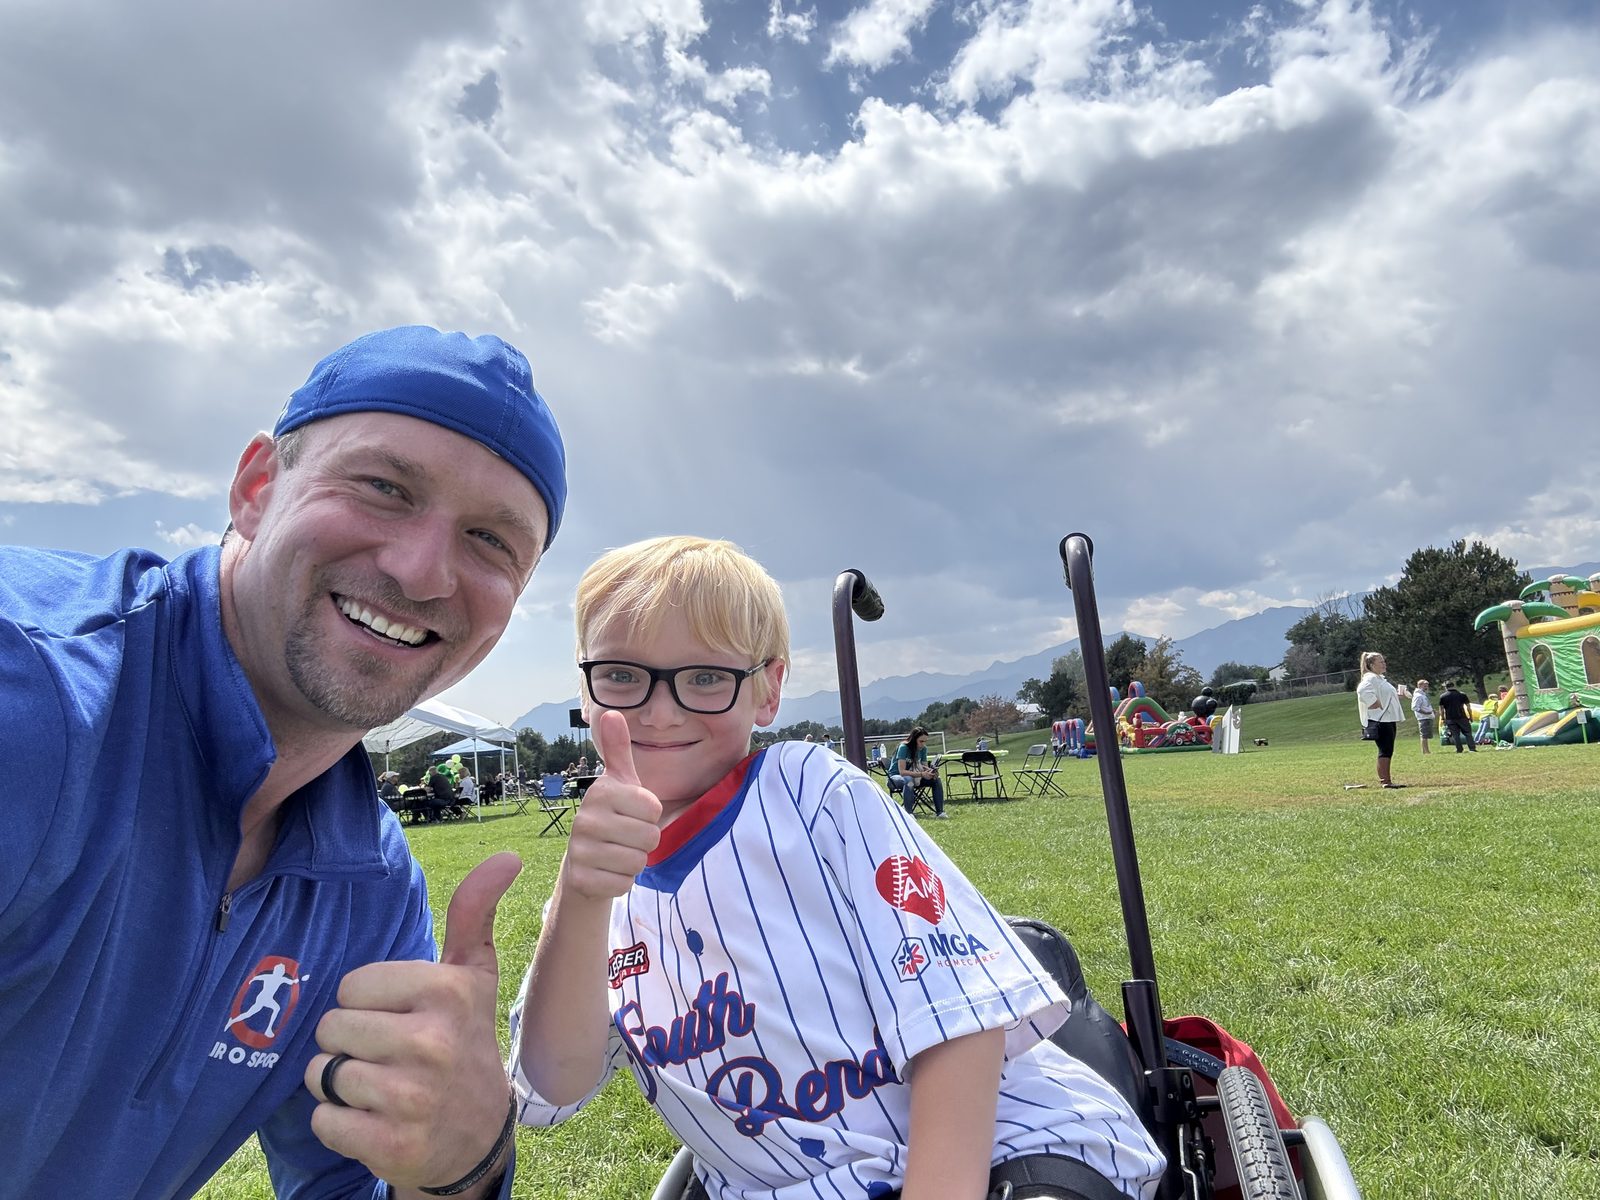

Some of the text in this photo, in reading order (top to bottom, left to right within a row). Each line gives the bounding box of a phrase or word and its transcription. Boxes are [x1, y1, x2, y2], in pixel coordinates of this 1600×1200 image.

[928, 934, 989, 956] MGA
[614, 972, 755, 1104] South
[705, 1024, 903, 1137] Bend
